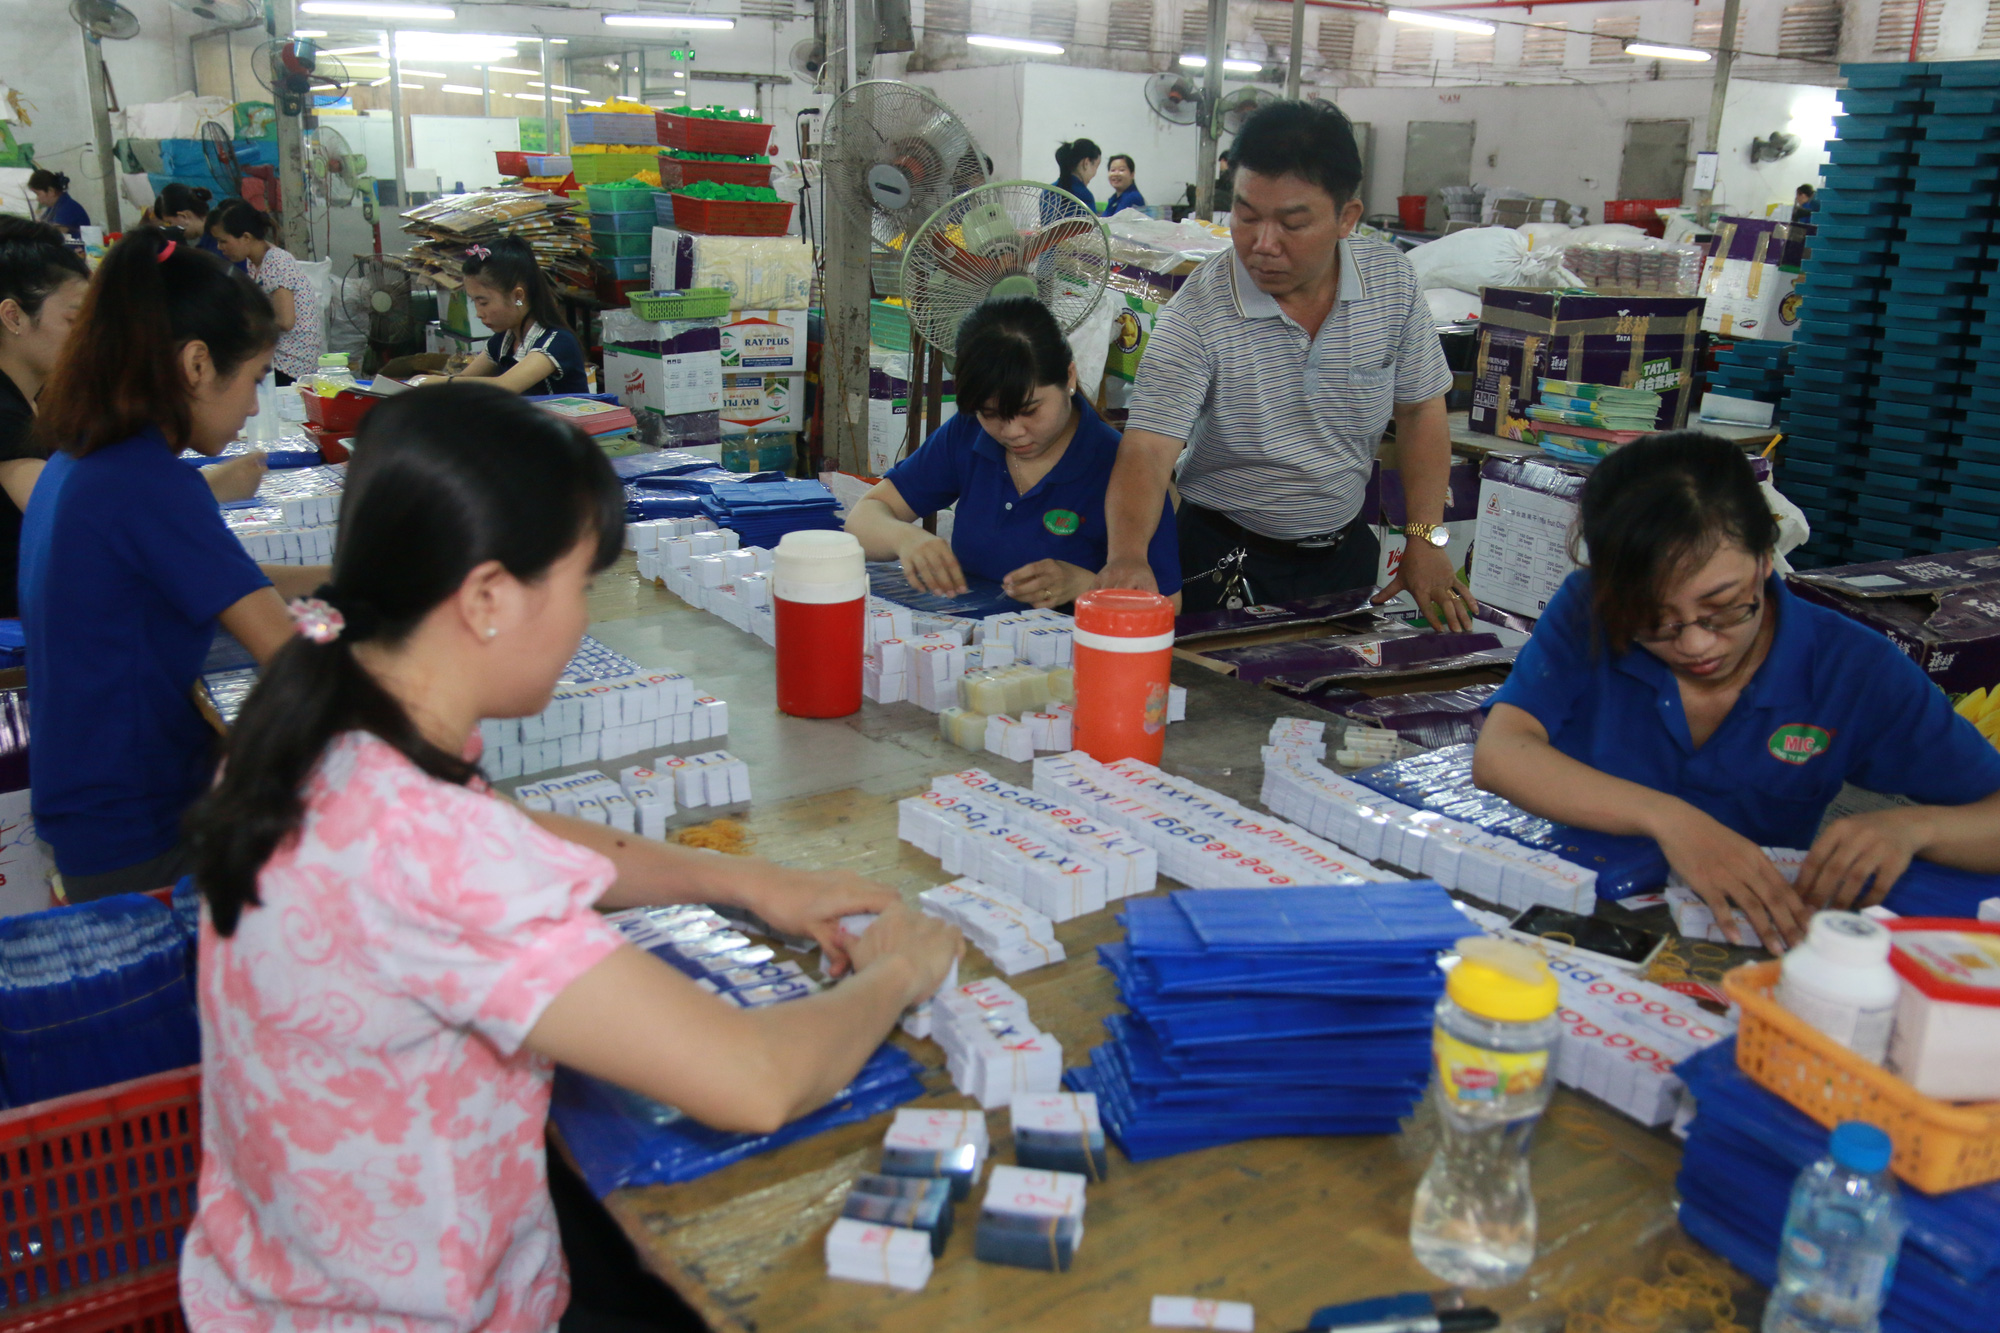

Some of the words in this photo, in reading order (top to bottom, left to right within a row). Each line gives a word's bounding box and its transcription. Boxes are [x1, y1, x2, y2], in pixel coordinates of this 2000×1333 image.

[744, 338, 764, 346] RAY
[766, 337, 790, 346] PLUS
[1643, 361, 1670, 376] TATA
[1784, 735, 1815, 752] MIC
